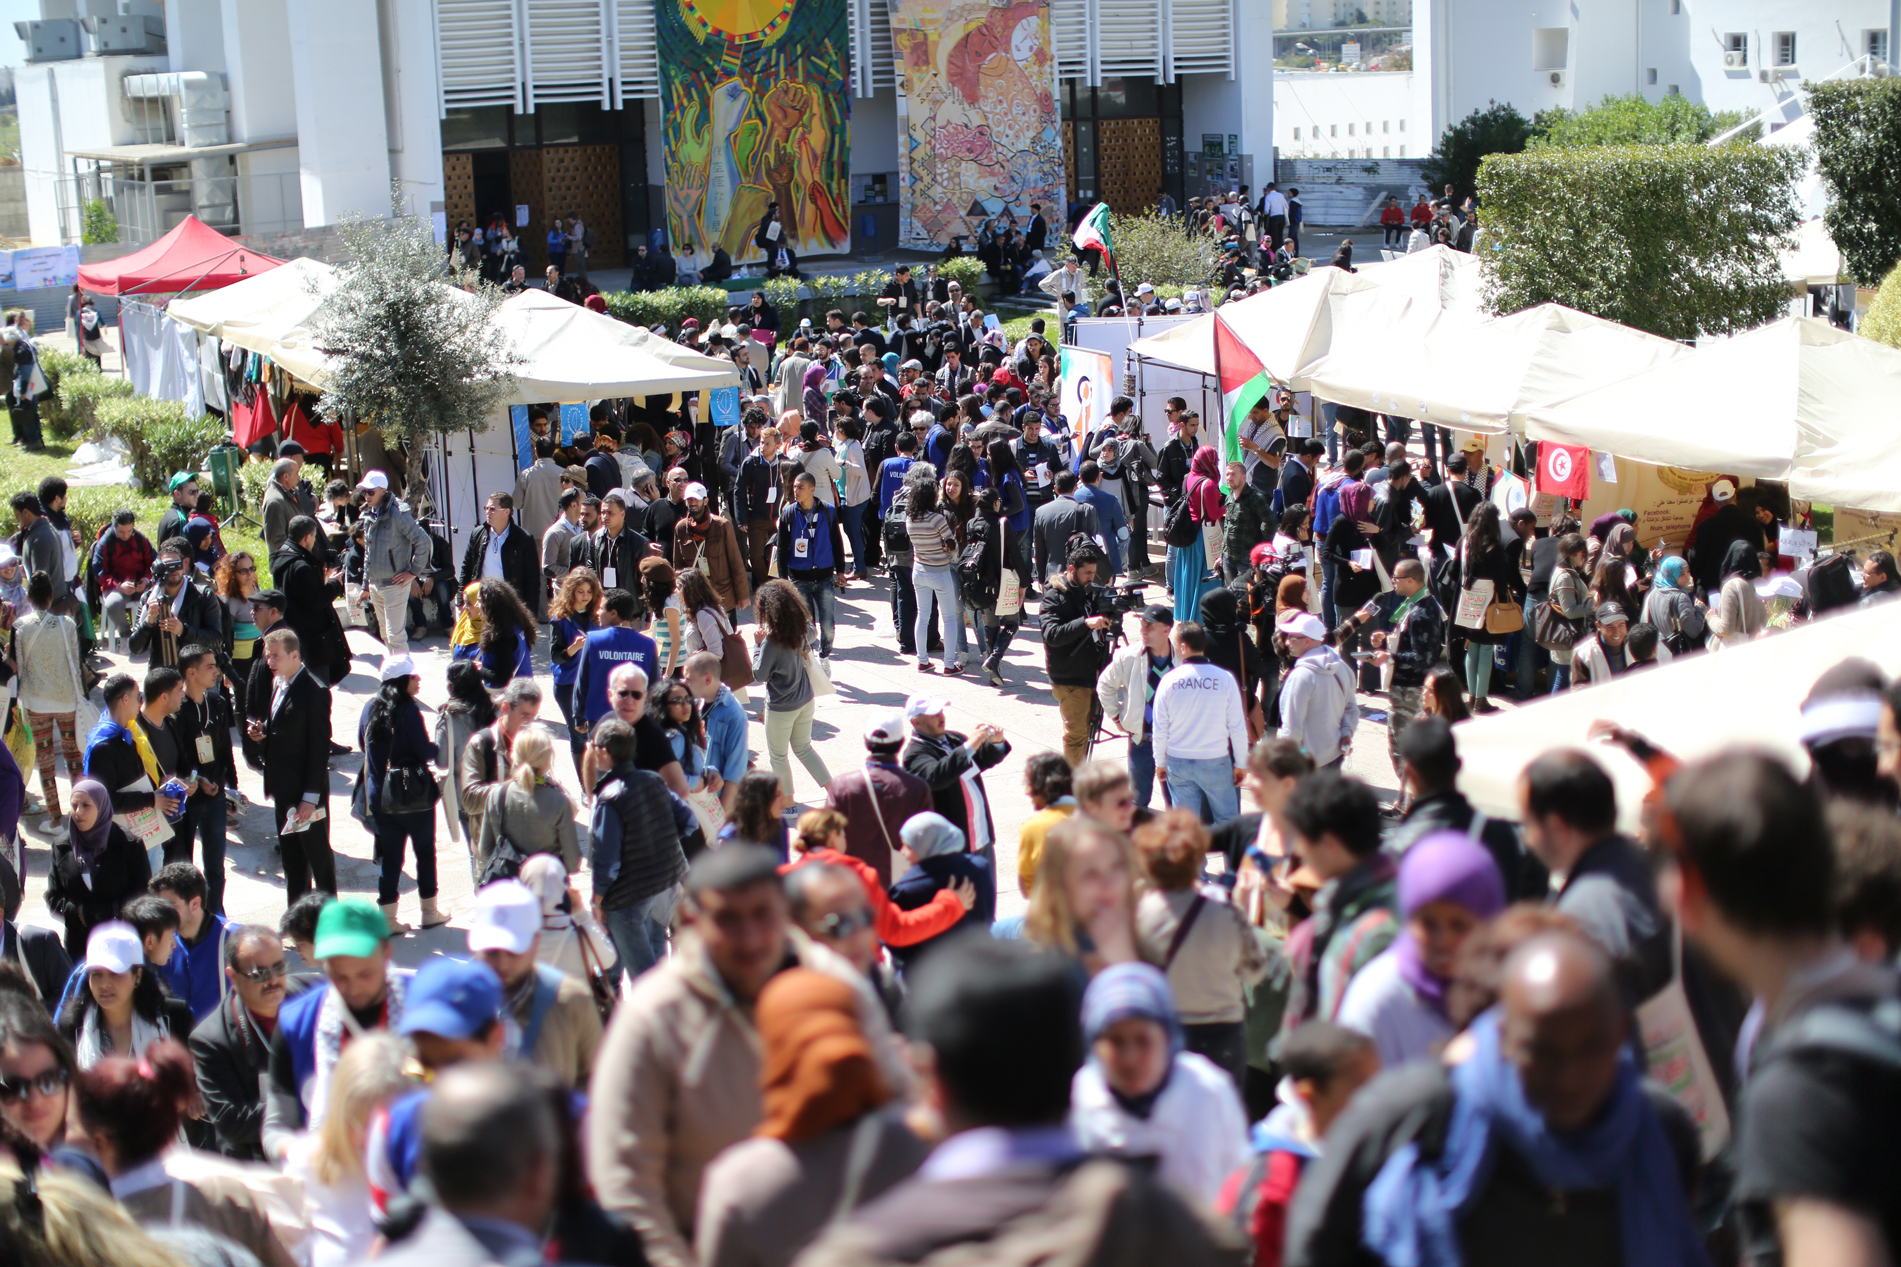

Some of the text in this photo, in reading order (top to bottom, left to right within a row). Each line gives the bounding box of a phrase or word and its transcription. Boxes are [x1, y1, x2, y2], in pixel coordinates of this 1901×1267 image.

[598, 650, 645, 662] VOLONTAIRE
[1172, 677, 1219, 690] FRANCE
[238, 1015, 250, 1047] DIGITAL
